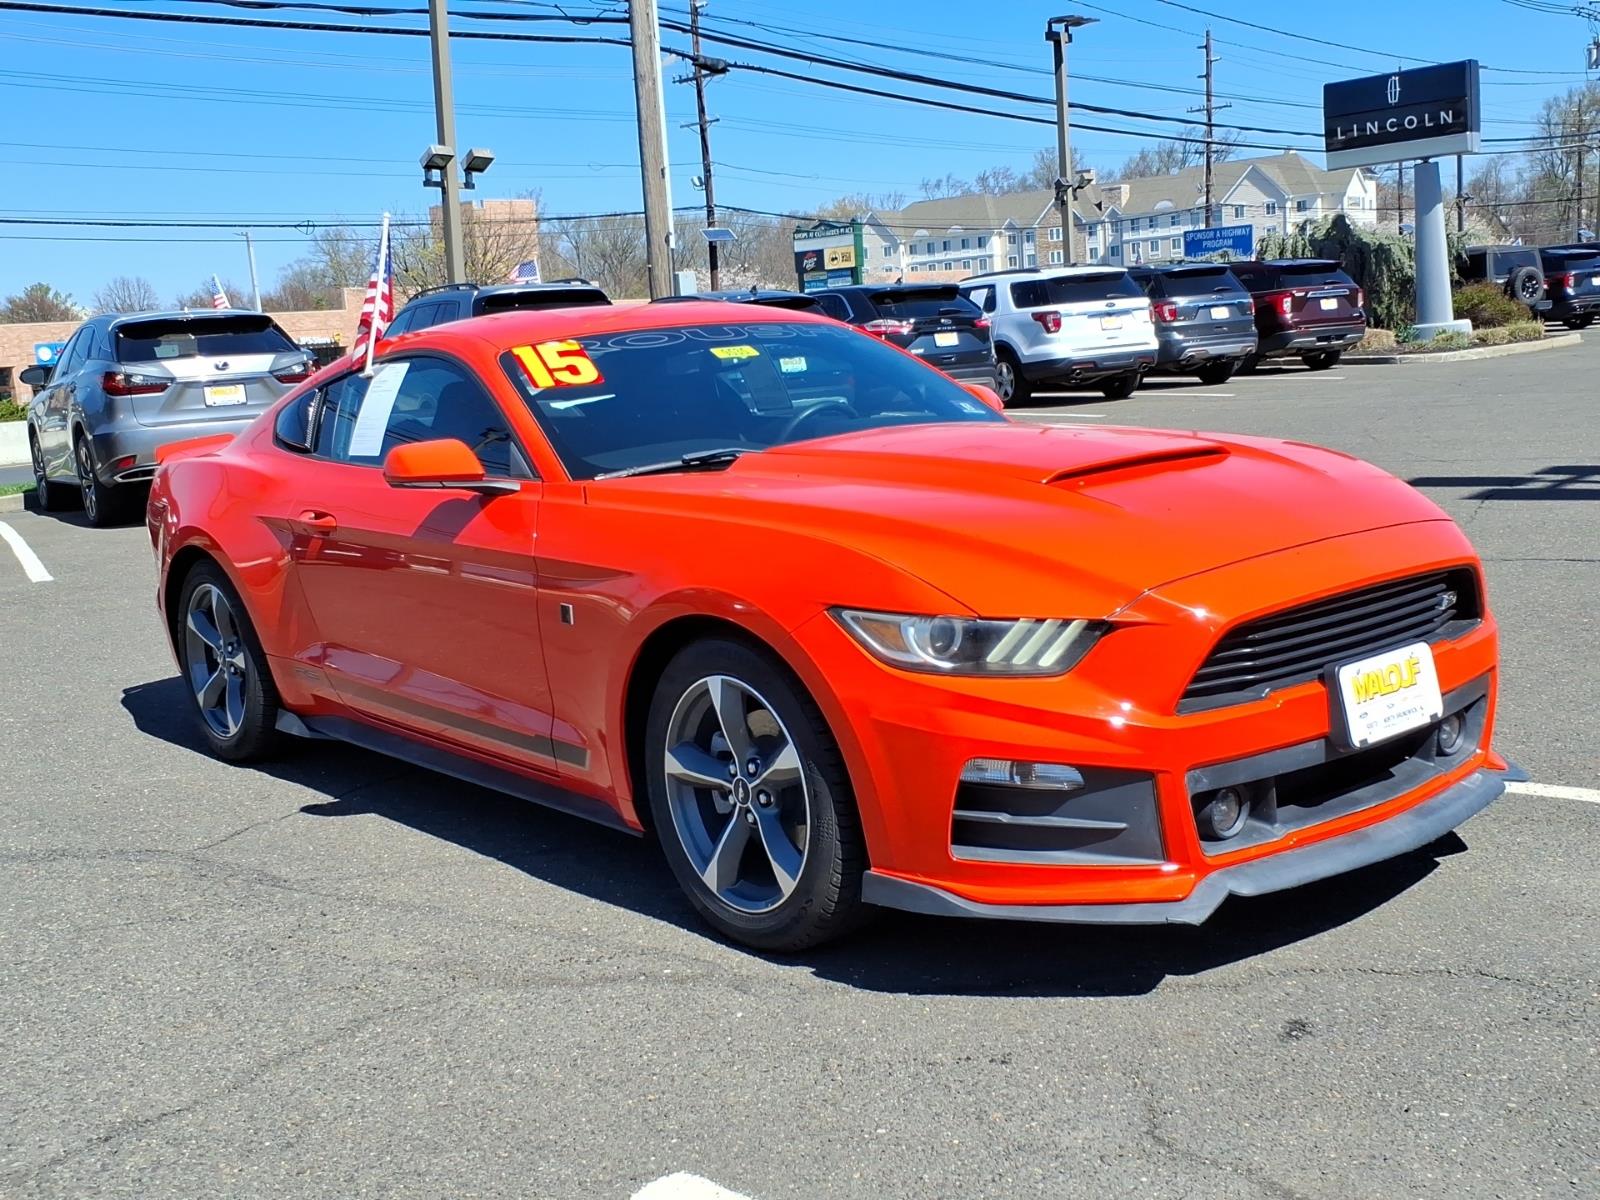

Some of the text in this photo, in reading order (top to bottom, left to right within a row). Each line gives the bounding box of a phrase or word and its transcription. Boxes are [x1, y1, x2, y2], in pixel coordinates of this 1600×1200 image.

[1337, 110, 1453, 140] LINCOLN
[1186, 231, 1214, 241] SPONSOR
[1222, 227, 1250, 237] HIGHWAY
[1203, 239, 1233, 248] PROGRAM
[512, 339, 598, 388] 15
[1352, 657, 1421, 704] MALOUF
